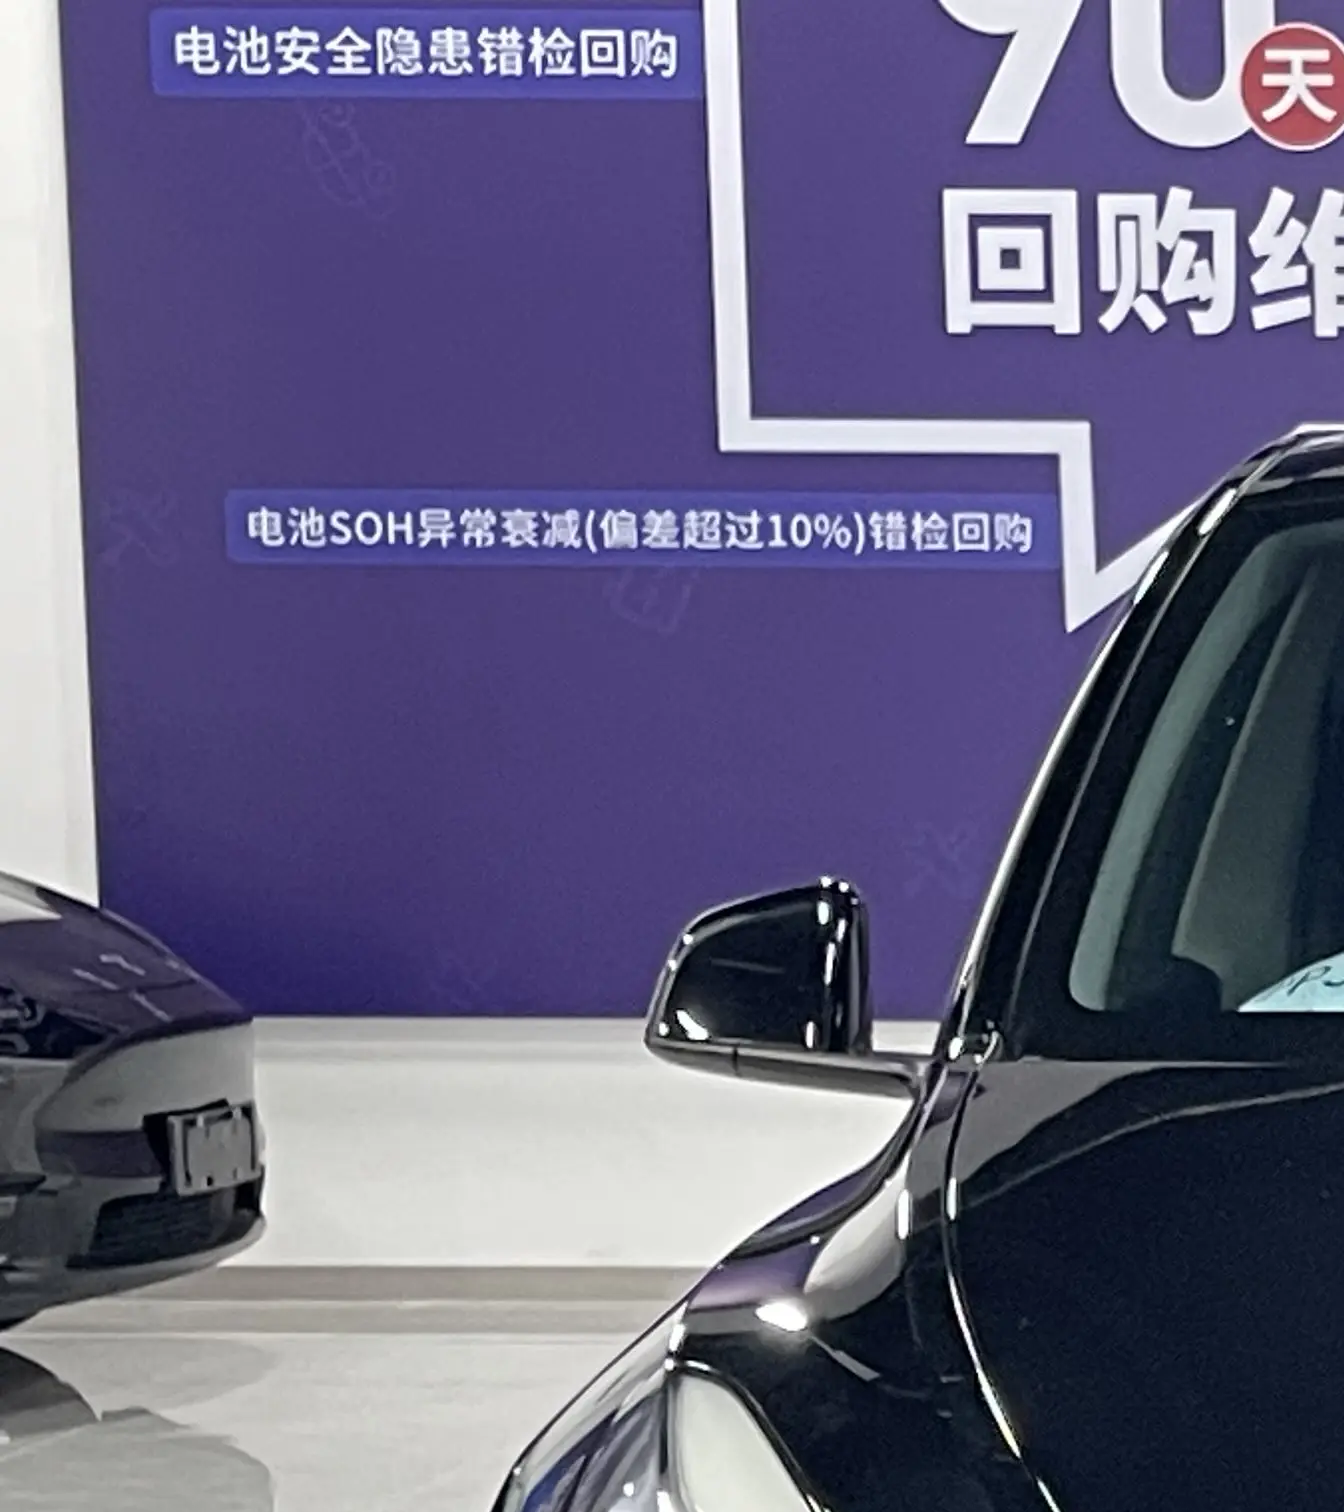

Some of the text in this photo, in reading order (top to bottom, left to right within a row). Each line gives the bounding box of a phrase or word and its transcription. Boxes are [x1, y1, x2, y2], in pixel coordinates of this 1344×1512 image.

[174, 26, 679, 78] 电池安全隐患错检回购
[247, 505, 1034, 555] 电池SOH异常衰减(偏差超过10%)错检回购
